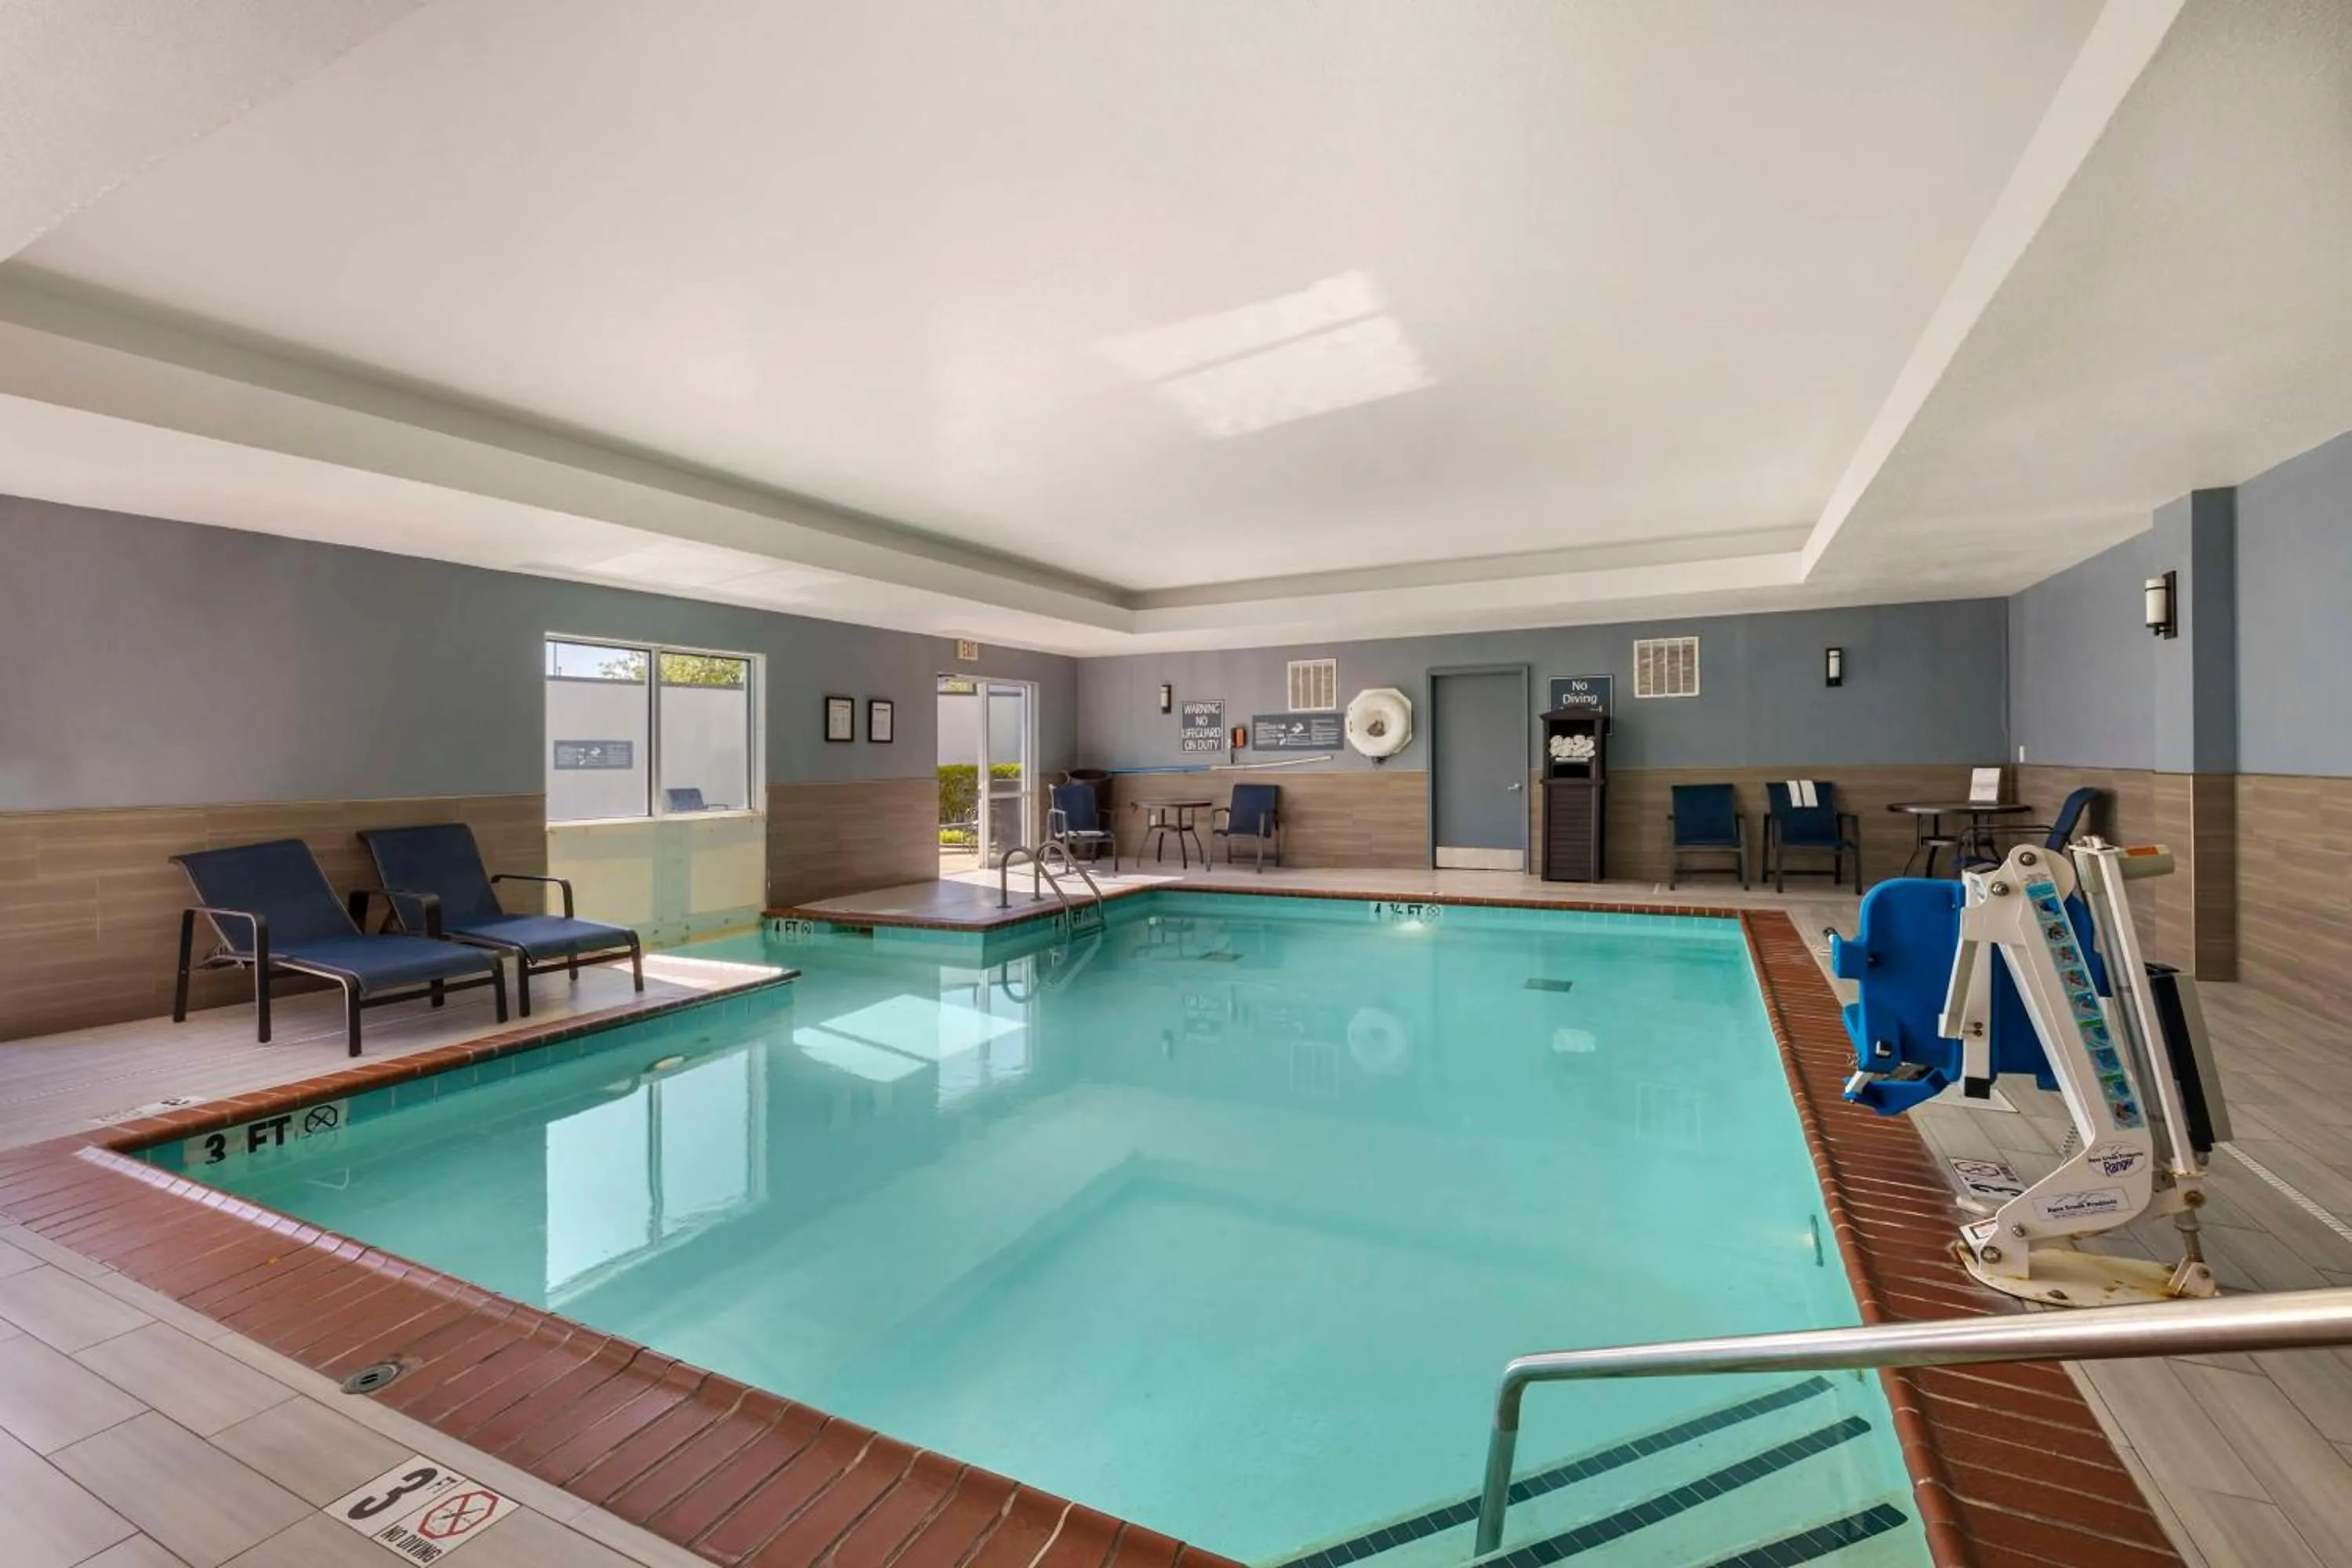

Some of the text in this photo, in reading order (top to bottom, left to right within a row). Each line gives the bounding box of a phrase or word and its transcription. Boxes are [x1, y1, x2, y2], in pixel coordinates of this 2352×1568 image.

[1572, 680, 1588, 691] No
[1563, 692, 1598, 705] Diving
[1185, 703, 1221, 715] WARNING
[1195, 715, 1208, 726] NO
[1182, 728, 1221, 739] LIFEGUARD
[1185, 739, 1218, 750] ON DUTY
[1408, 904, 1424, 916] FT
[785, 920, 799, 933] FT
[205, 1115, 291, 1165] 3 FT
[347, 1467, 438, 1520] 3
[380, 1525, 442, 1563] NO DIVING
